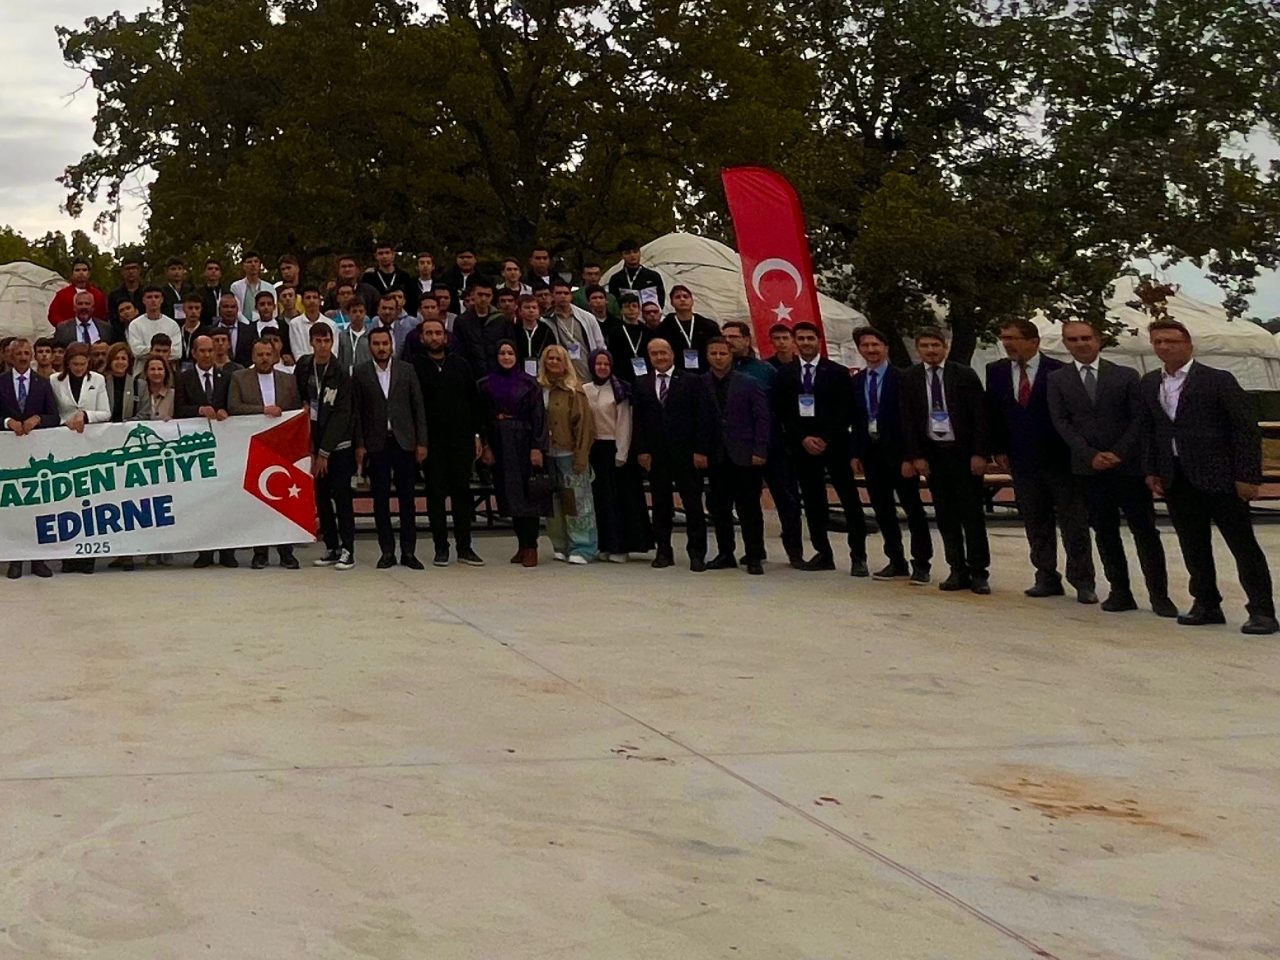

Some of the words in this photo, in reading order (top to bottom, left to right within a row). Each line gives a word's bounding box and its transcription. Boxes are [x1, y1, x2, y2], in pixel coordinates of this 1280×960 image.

[124, 450, 218, 488] ATİYE
[35, 494, 175, 545] EDİRNE
[75, 541, 111, 555] 2025
